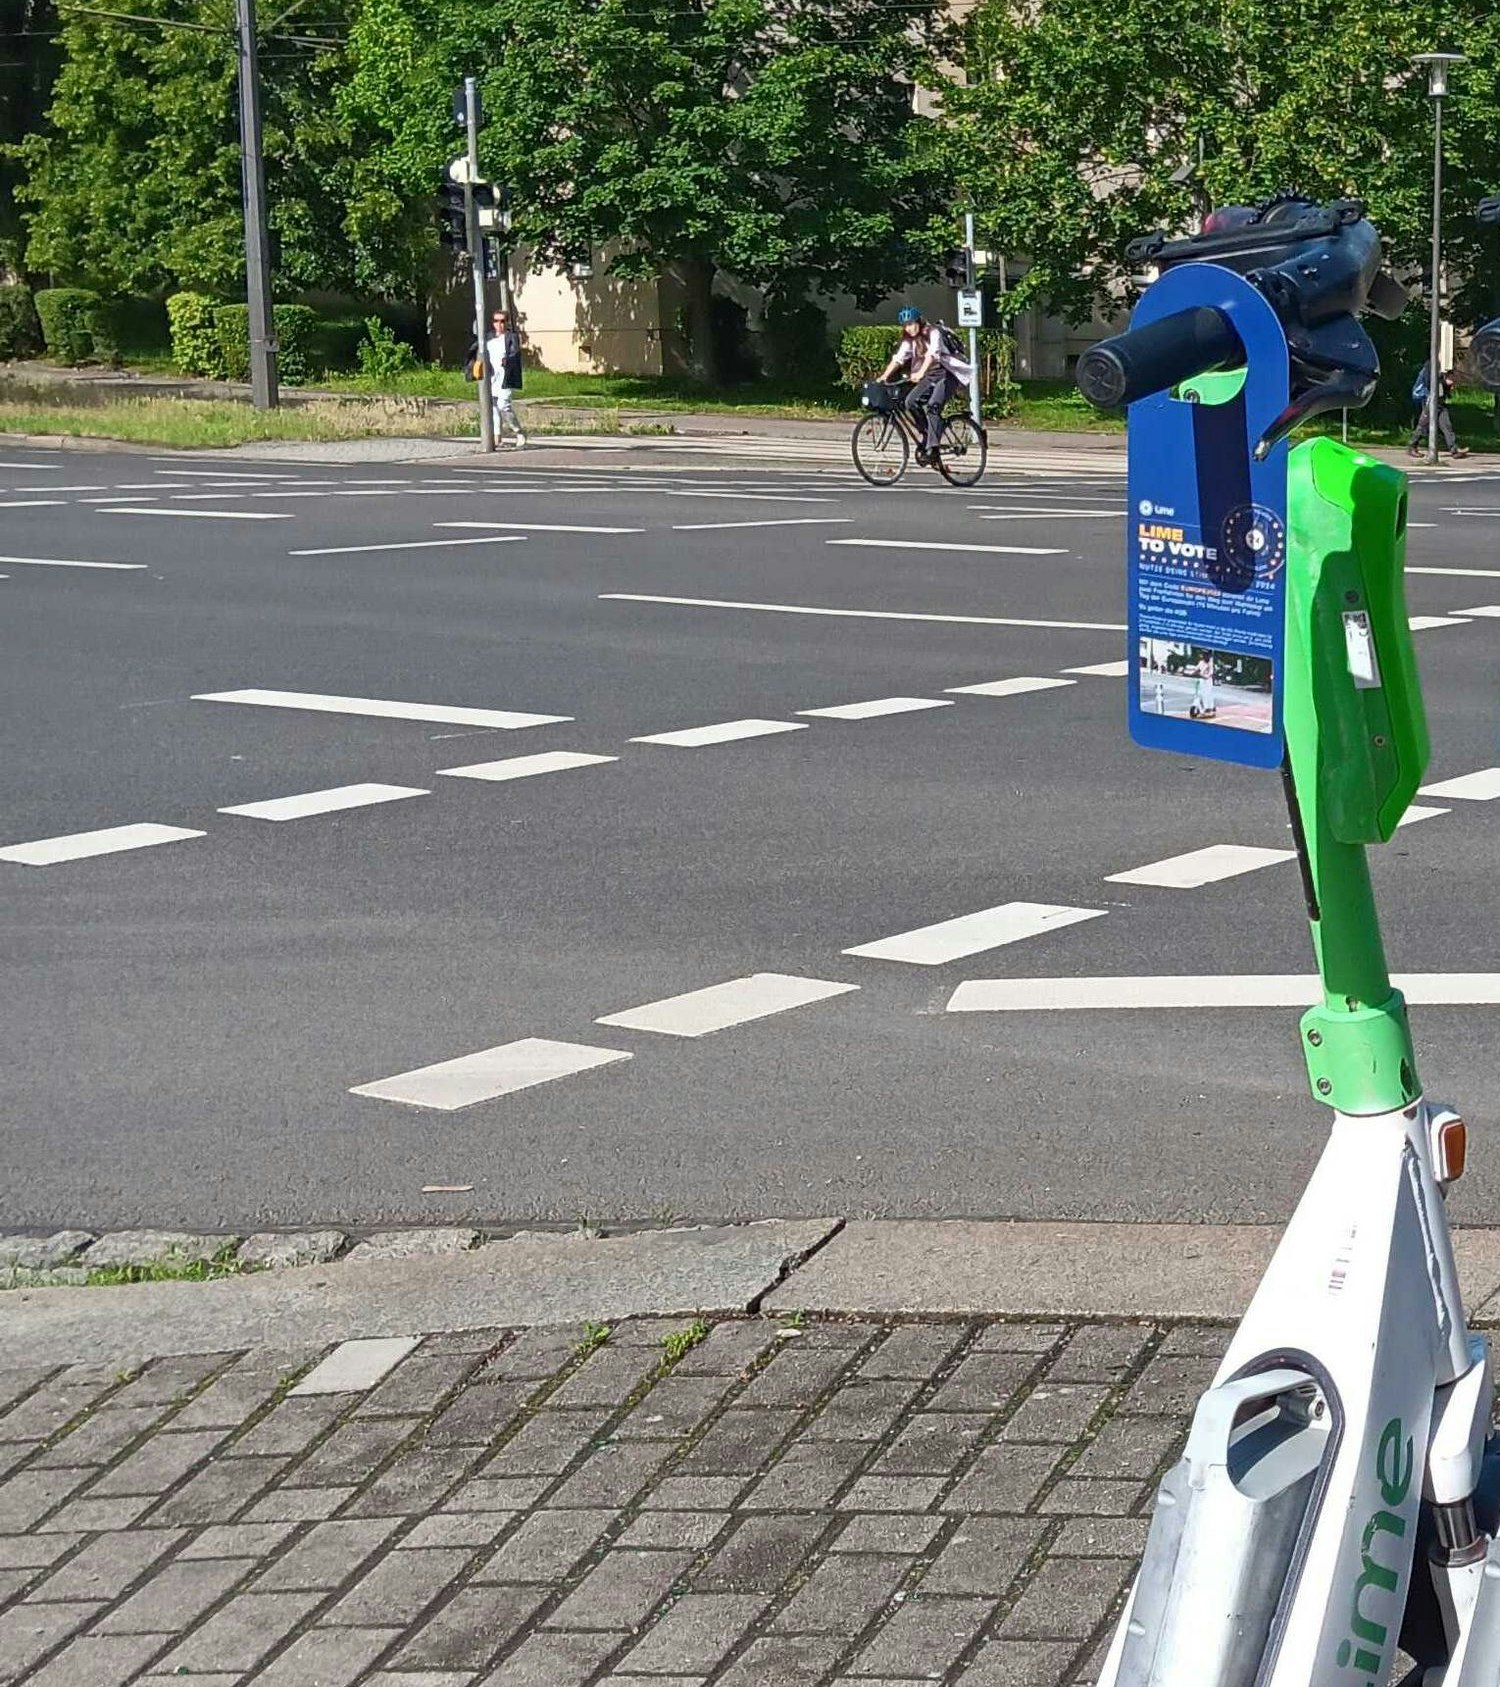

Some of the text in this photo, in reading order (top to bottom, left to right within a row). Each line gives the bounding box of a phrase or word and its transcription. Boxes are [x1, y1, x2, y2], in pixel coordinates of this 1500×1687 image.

[1138, 524, 1184, 542] LIME
[1138, 537, 1218, 561] TO VOTE
[1336, 1417, 1413, 1687] ime
